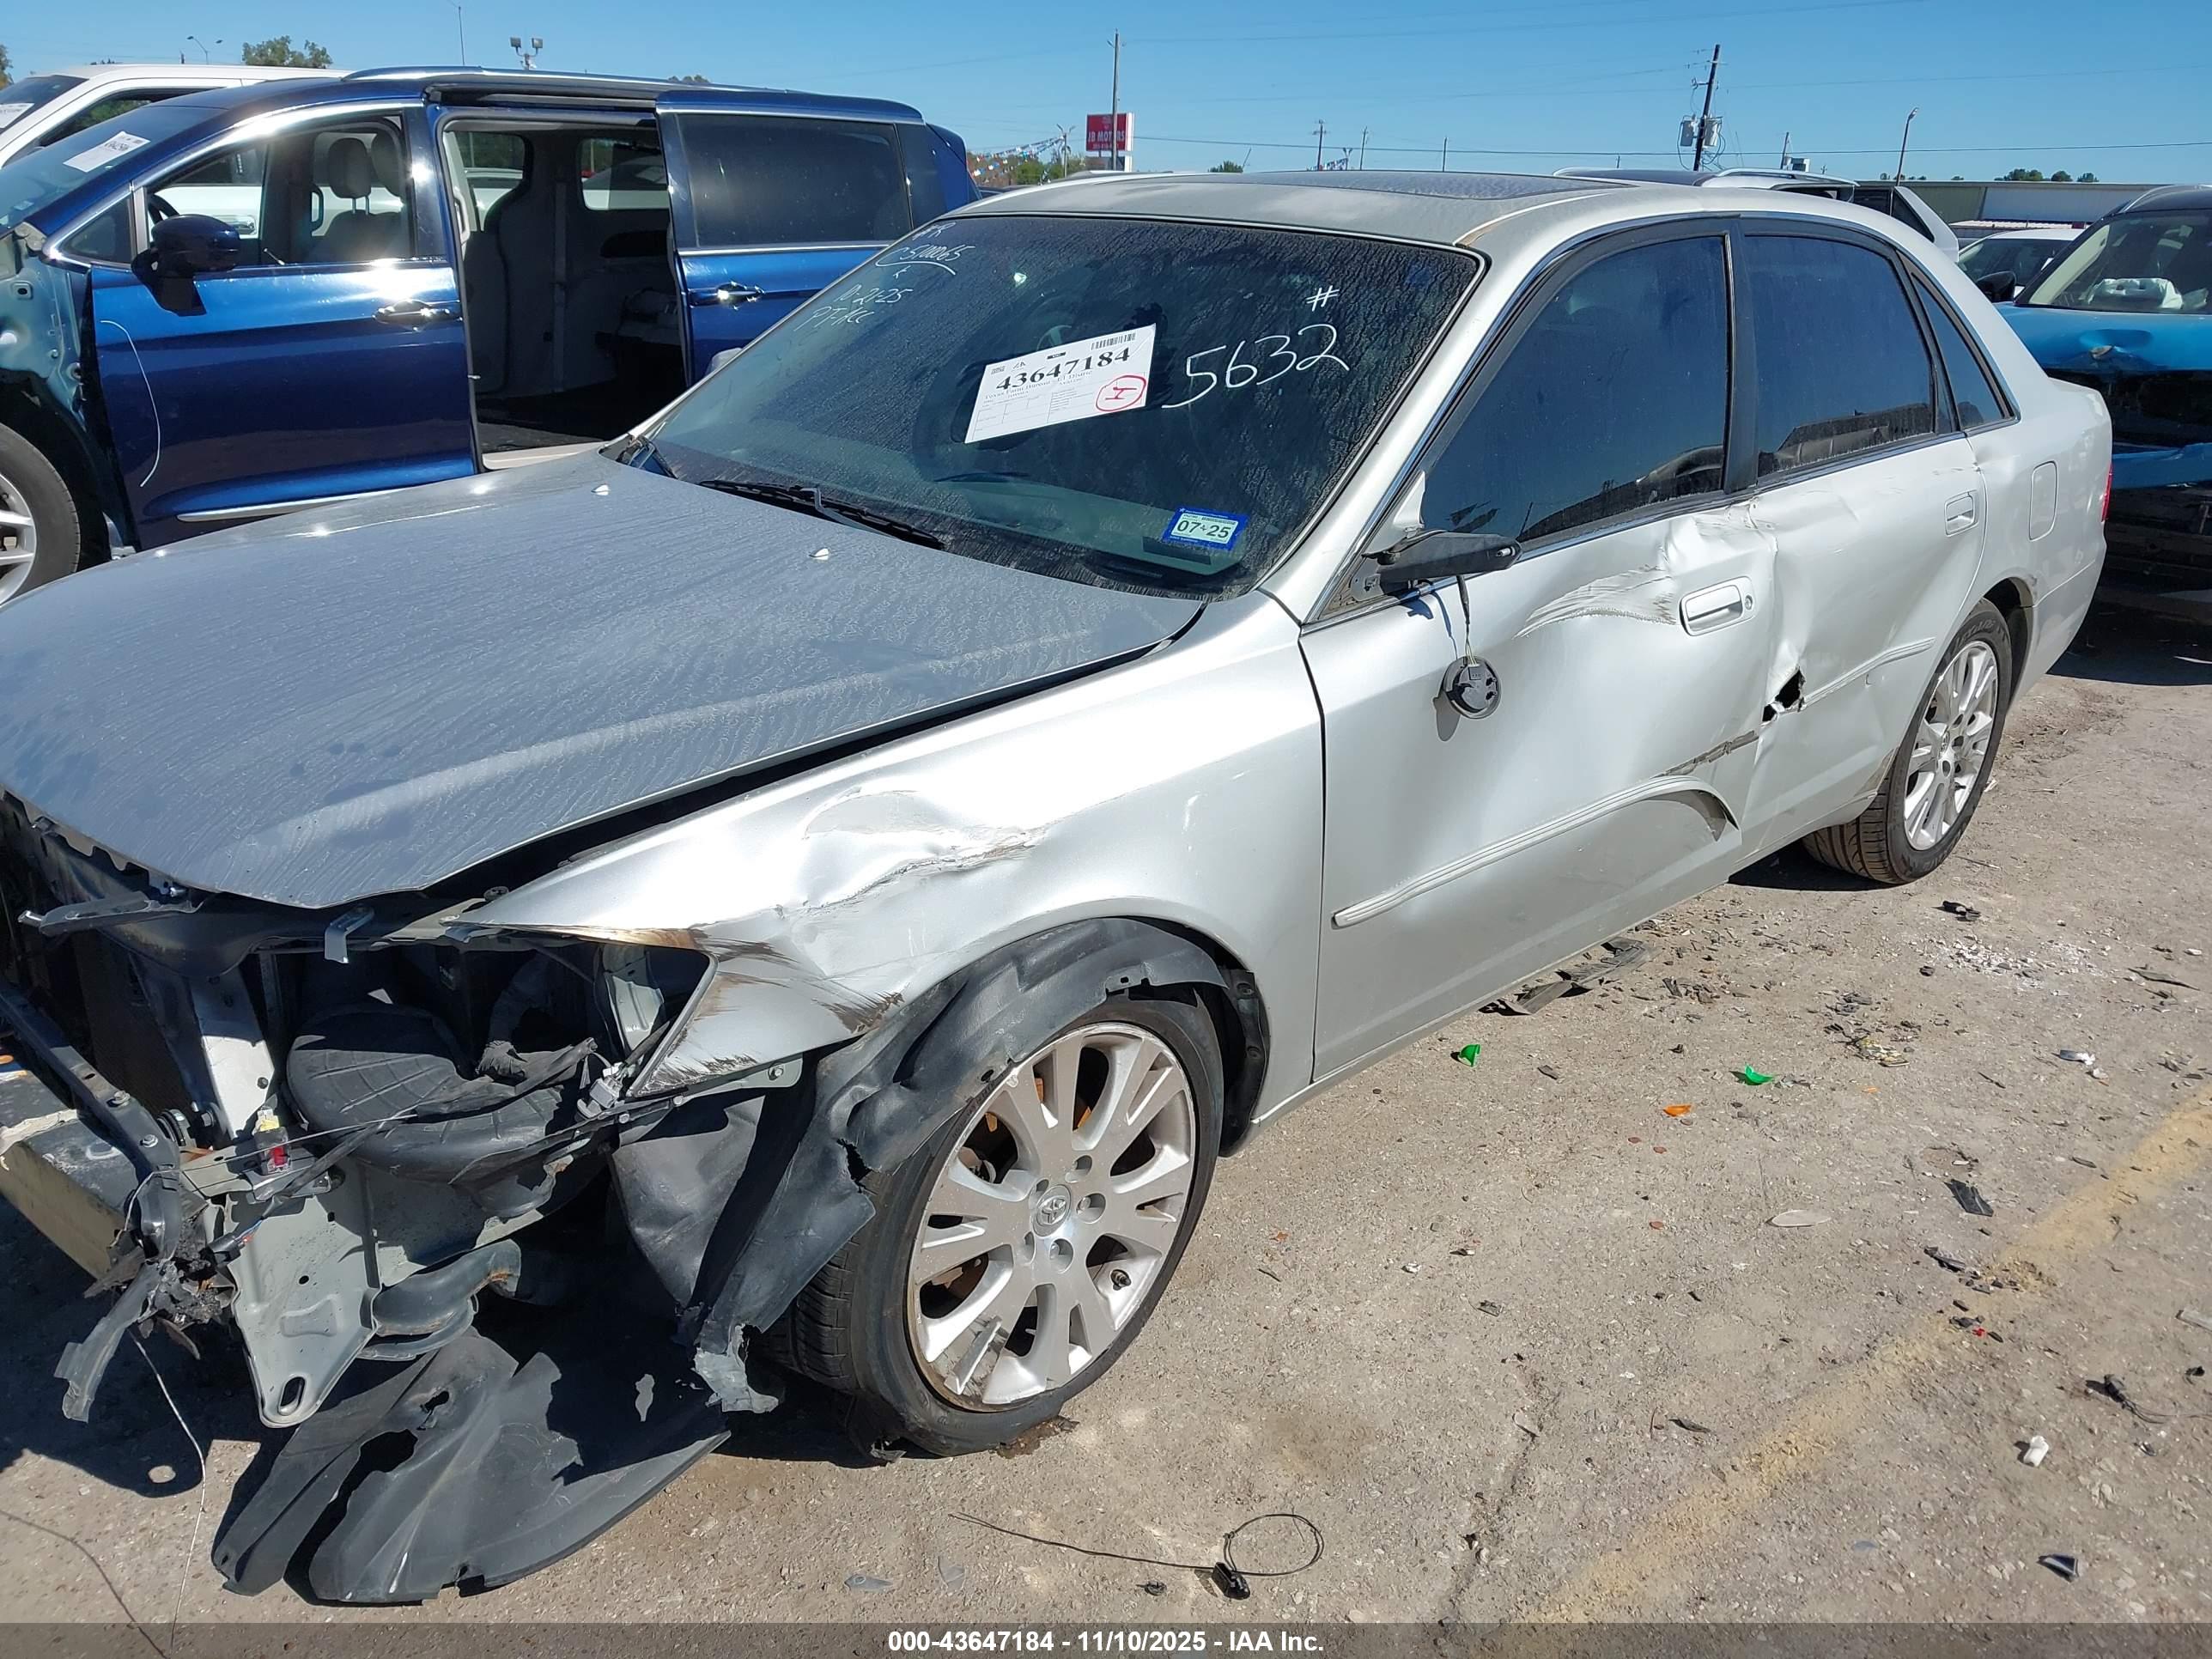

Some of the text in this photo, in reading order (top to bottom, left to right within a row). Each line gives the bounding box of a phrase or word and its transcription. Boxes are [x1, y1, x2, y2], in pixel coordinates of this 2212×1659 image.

[1097, 131, 1125, 142] MOTRS
[1305, 285, 1340, 312] #
[995, 346, 1131, 391] 43647184
[1162, 323, 1350, 408] 5632
[1176, 520, 1232, 538] 07 25
